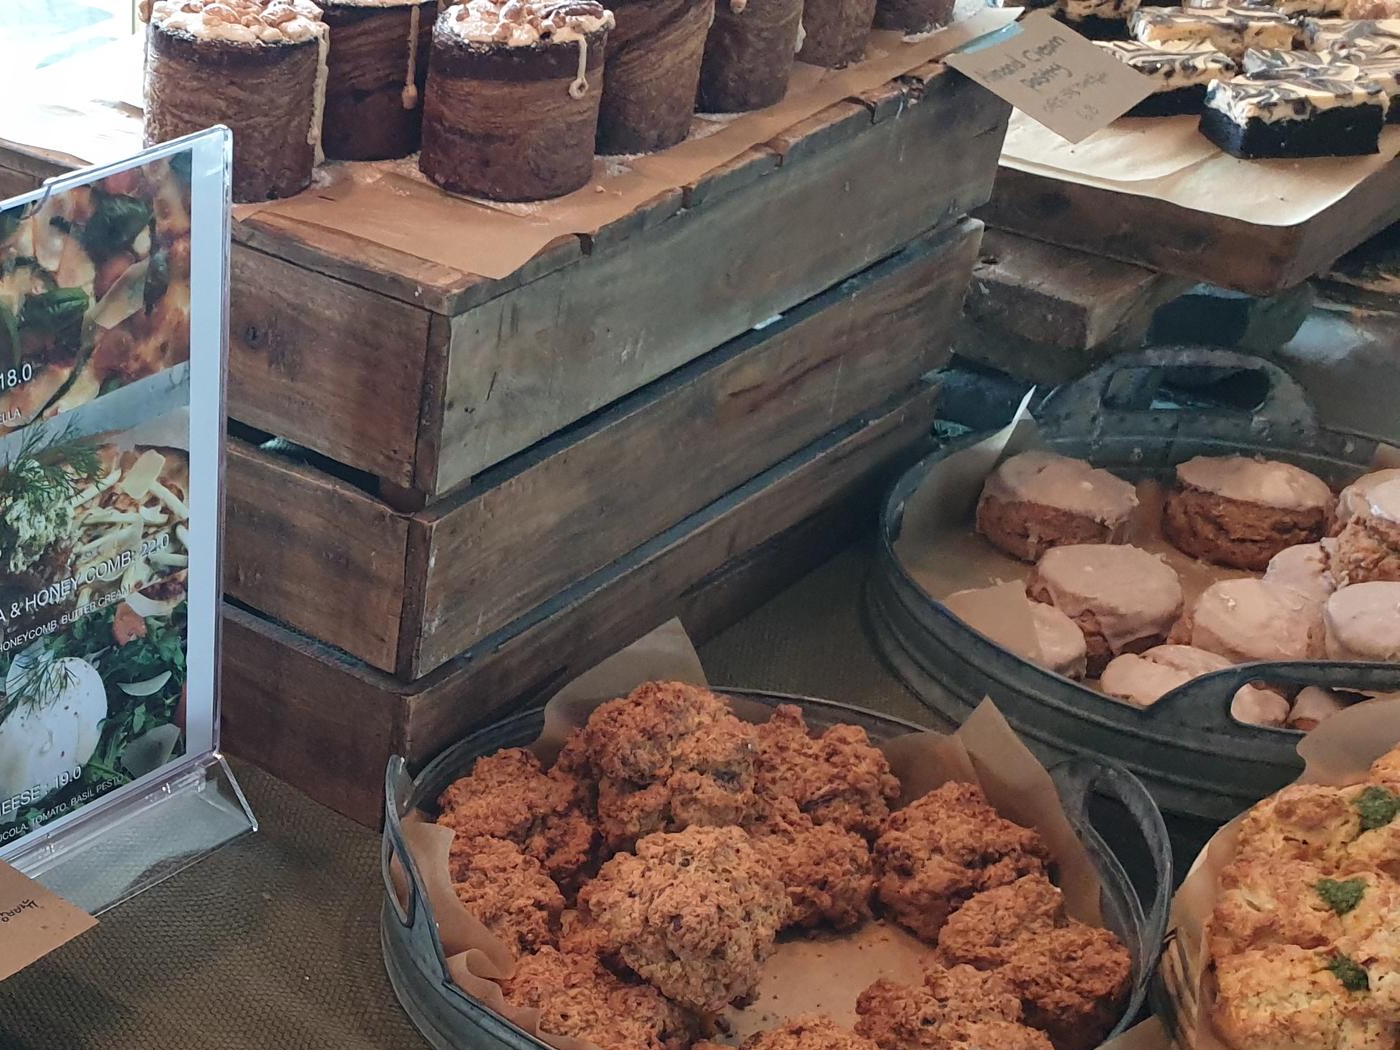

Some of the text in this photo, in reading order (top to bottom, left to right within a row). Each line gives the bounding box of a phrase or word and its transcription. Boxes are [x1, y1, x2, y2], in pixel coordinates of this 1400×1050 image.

[10, 602, 21, 618] &
[25, 577, 78, 613] HONEY
[61, 604, 97, 625] BUTTER
[55, 766, 82, 789] 19.0
[70, 787, 95, 807] BASIL
[96, 773, 124, 793] PESTO
